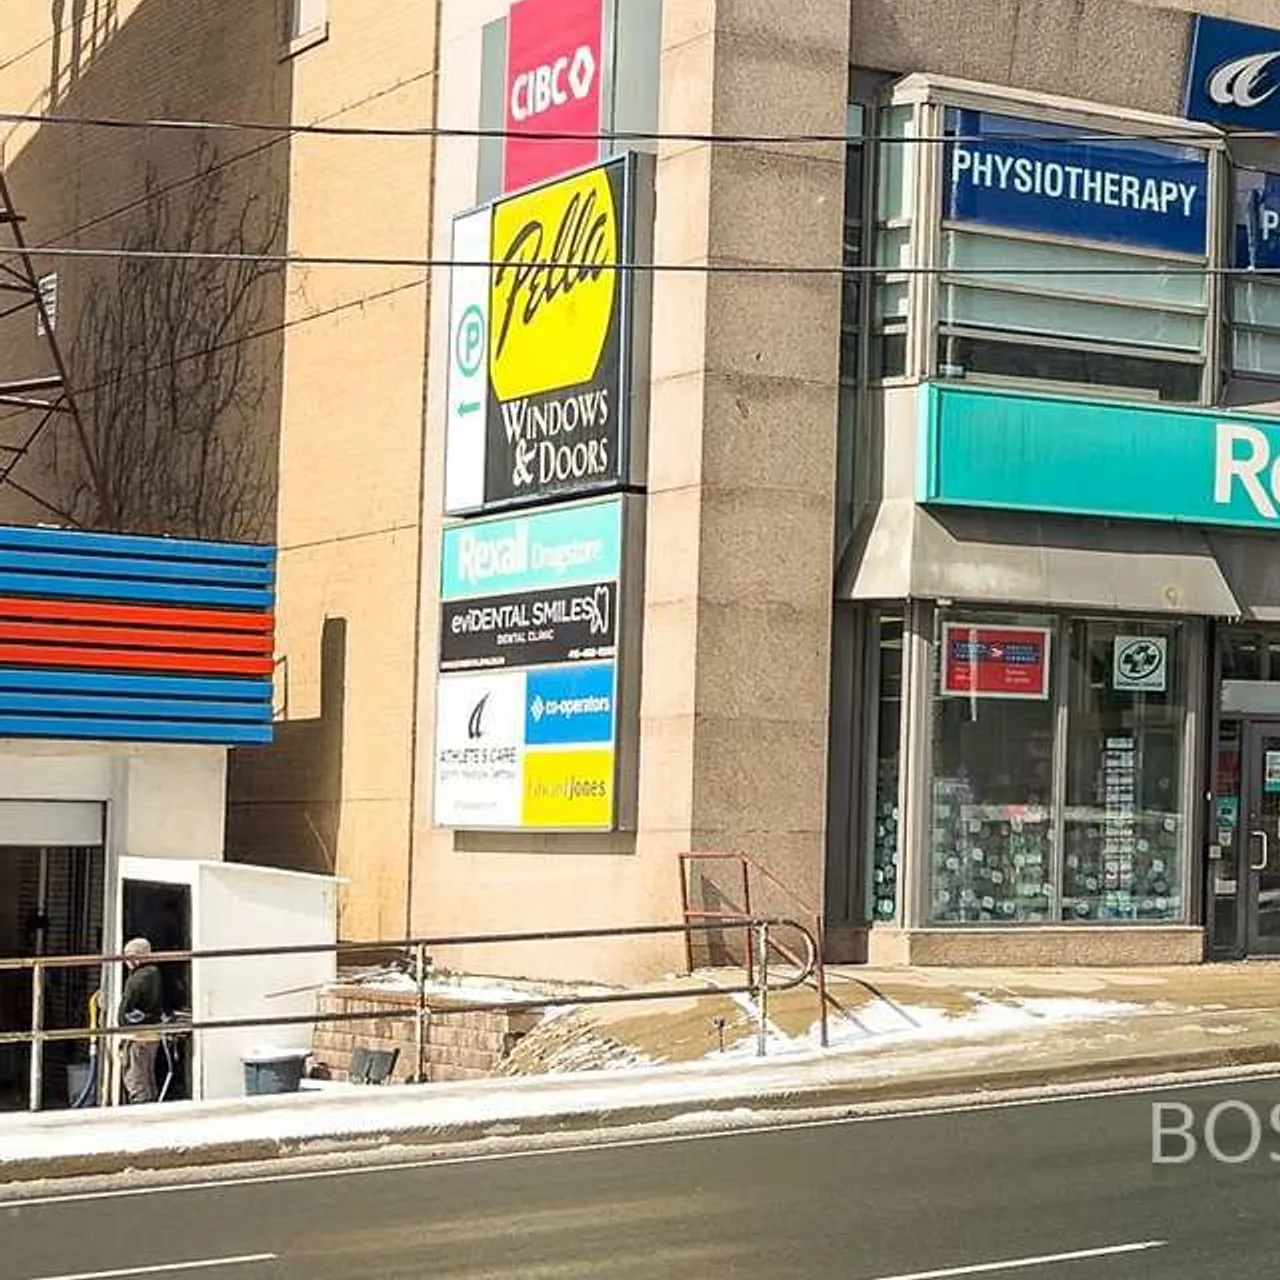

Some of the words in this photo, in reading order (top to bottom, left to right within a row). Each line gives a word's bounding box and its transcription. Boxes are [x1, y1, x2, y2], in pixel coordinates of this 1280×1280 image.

[511, 55, 568, 122] CIBC
[953, 148, 1197, 217] PHYSIOTHERAPY
[494, 189, 609, 361] Pella
[501, 389, 608, 446] WINDOWS
[539, 437, 608, 484] DOORS
[458, 521, 529, 586] Rexall
[451, 603, 529, 634] eviDENTAL
[532, 596, 593, 626] SMILES
